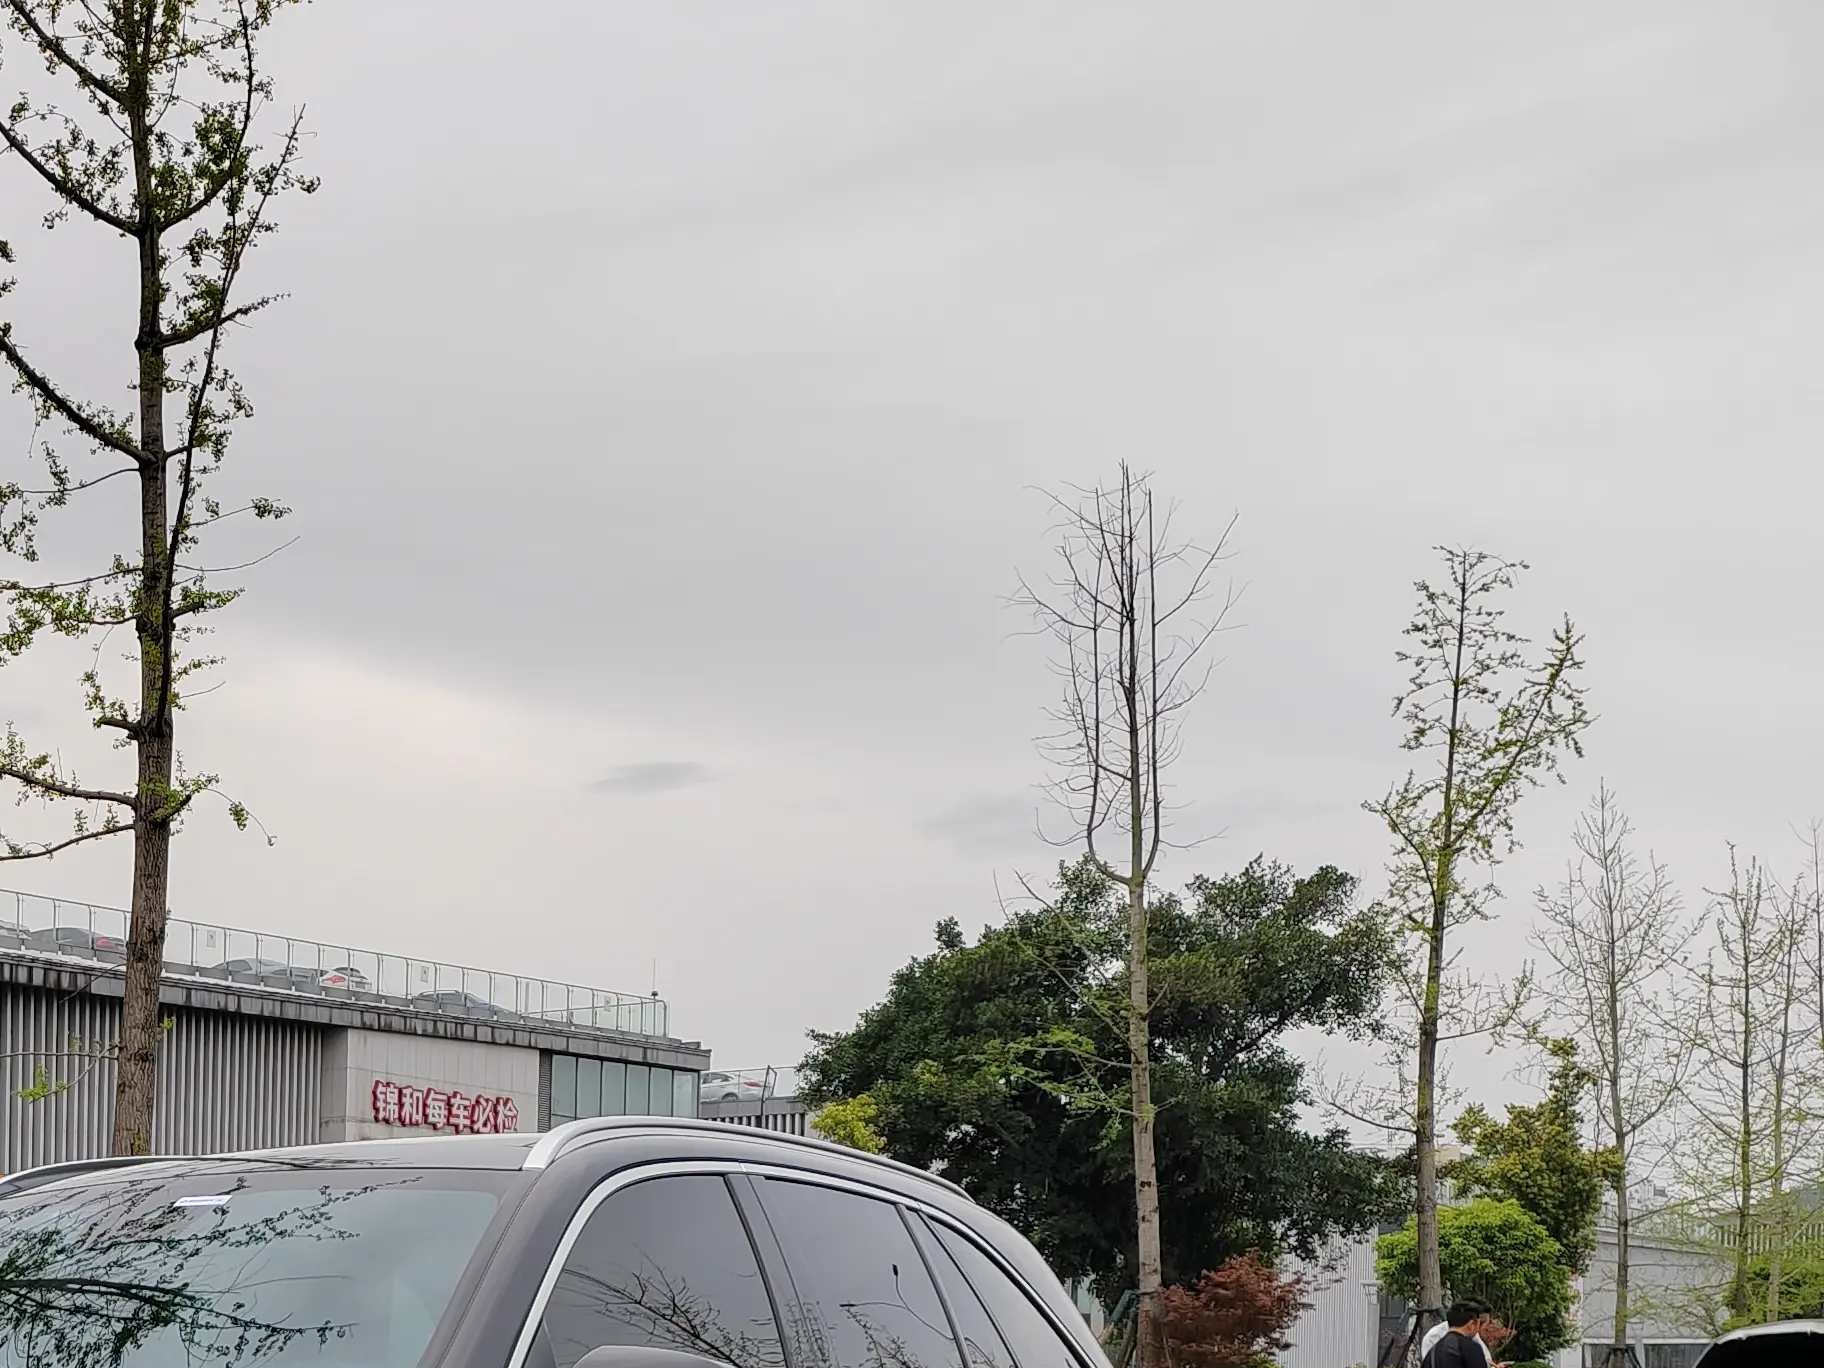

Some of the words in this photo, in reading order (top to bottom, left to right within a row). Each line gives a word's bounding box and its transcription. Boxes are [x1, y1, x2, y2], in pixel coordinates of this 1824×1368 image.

[372, 1080, 521, 1134] 锦和每车必检
